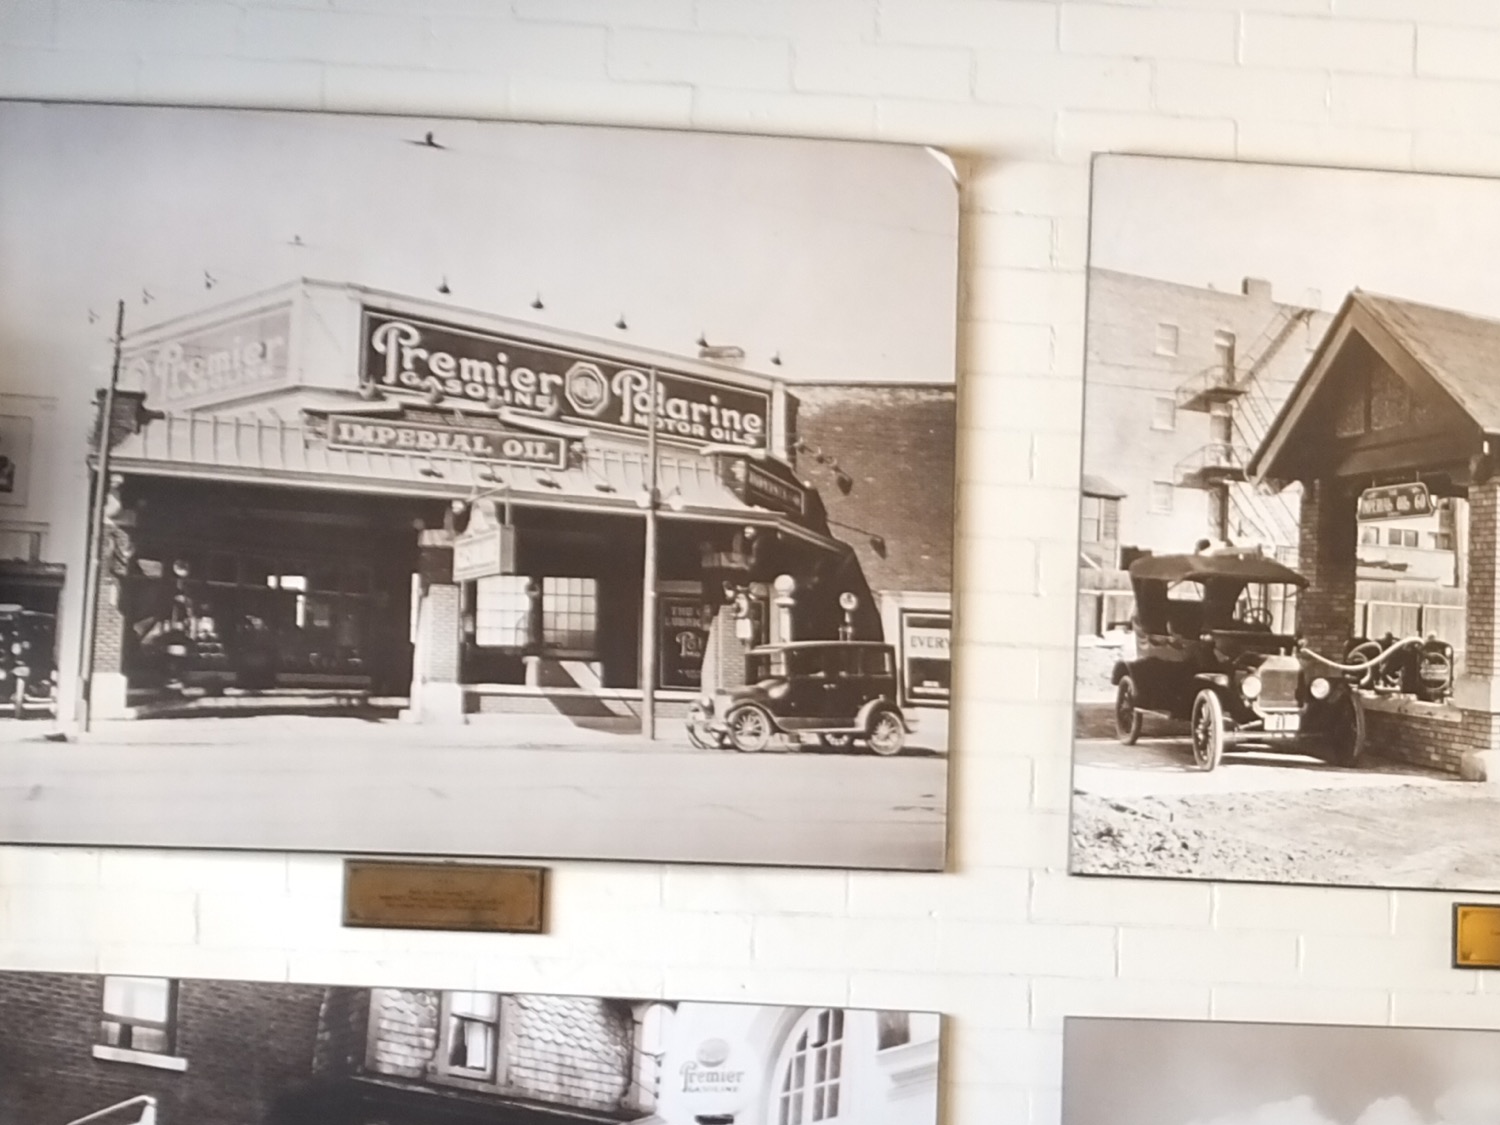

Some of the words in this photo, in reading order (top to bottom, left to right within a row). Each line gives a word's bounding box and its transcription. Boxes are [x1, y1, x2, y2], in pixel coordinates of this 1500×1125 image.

[372, 321, 564, 394] Premier
[612, 369, 763, 434] Polarine
[338, 422, 493, 456] IMPERIAL
[502, 437, 556, 463] OIL
[633, 413, 704, 437] MOTOR
[709, 426, 758, 447] OILS
[680, 1061, 745, 1091] Premier
